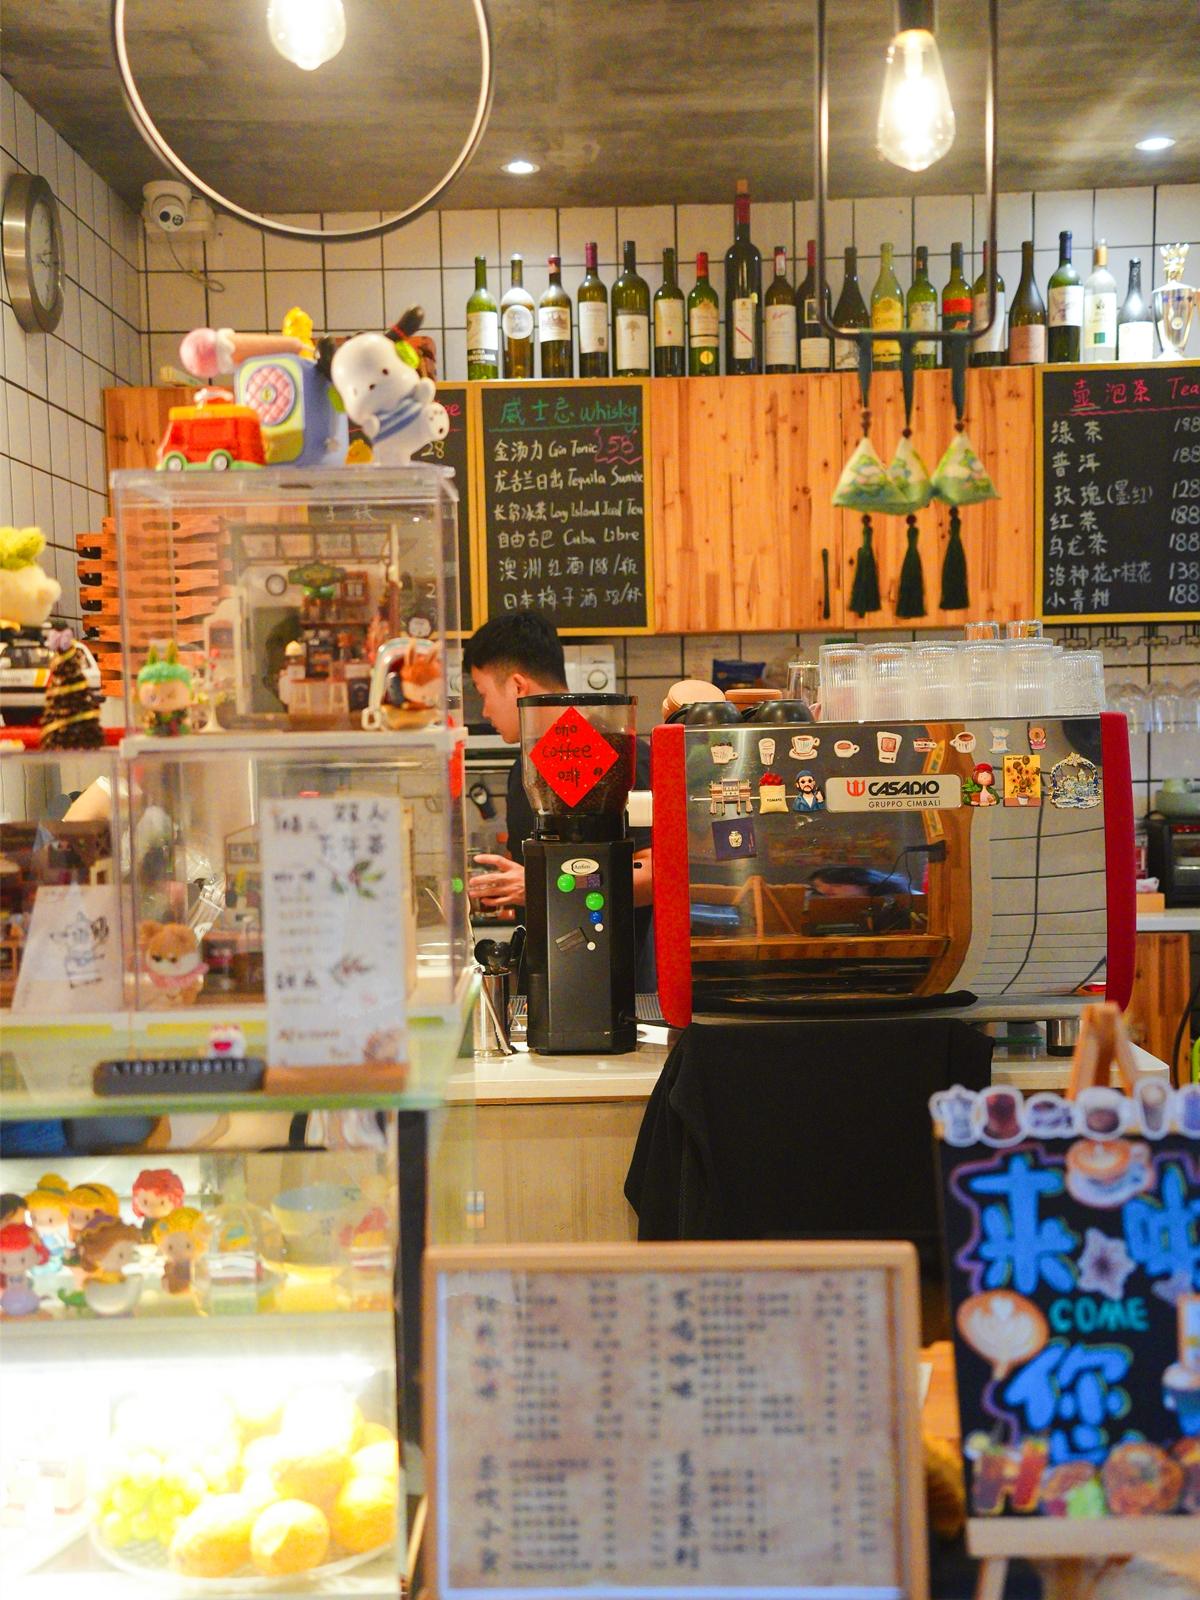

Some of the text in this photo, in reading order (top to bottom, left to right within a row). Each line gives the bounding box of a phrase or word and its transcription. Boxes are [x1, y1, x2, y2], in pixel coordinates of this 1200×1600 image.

[1168, 376, 1200, 400] Tea
[1050, 420, 1103, 444] 绿茶
[494, 438, 599, 462] 金汤力 Gin Tonic
[1052, 445, 1200, 478] 普洱 188
[494, 468, 563, 493] 龙舌兰日出
[568, 468, 606, 490] Tequila
[1172, 479, 1200, 499] 128
[571, 500, 600, 517] Island
[1050, 505, 1200, 531] 红茶 188
[498, 526, 640, 549] 自由古巴 Cuba Libre
[1049, 532, 1200, 559] 乌龙茶 188
[499, 556, 584, 582] 澳洲红酒
[1169, 561, 1200, 581] 138
[504, 585, 598, 611] 日本梅子酒
[1046, 583, 1200, 613] 小青柑 188
[868, 781, 940, 796] CASADIO
[1048, 1297, 1149, 1331] COME
